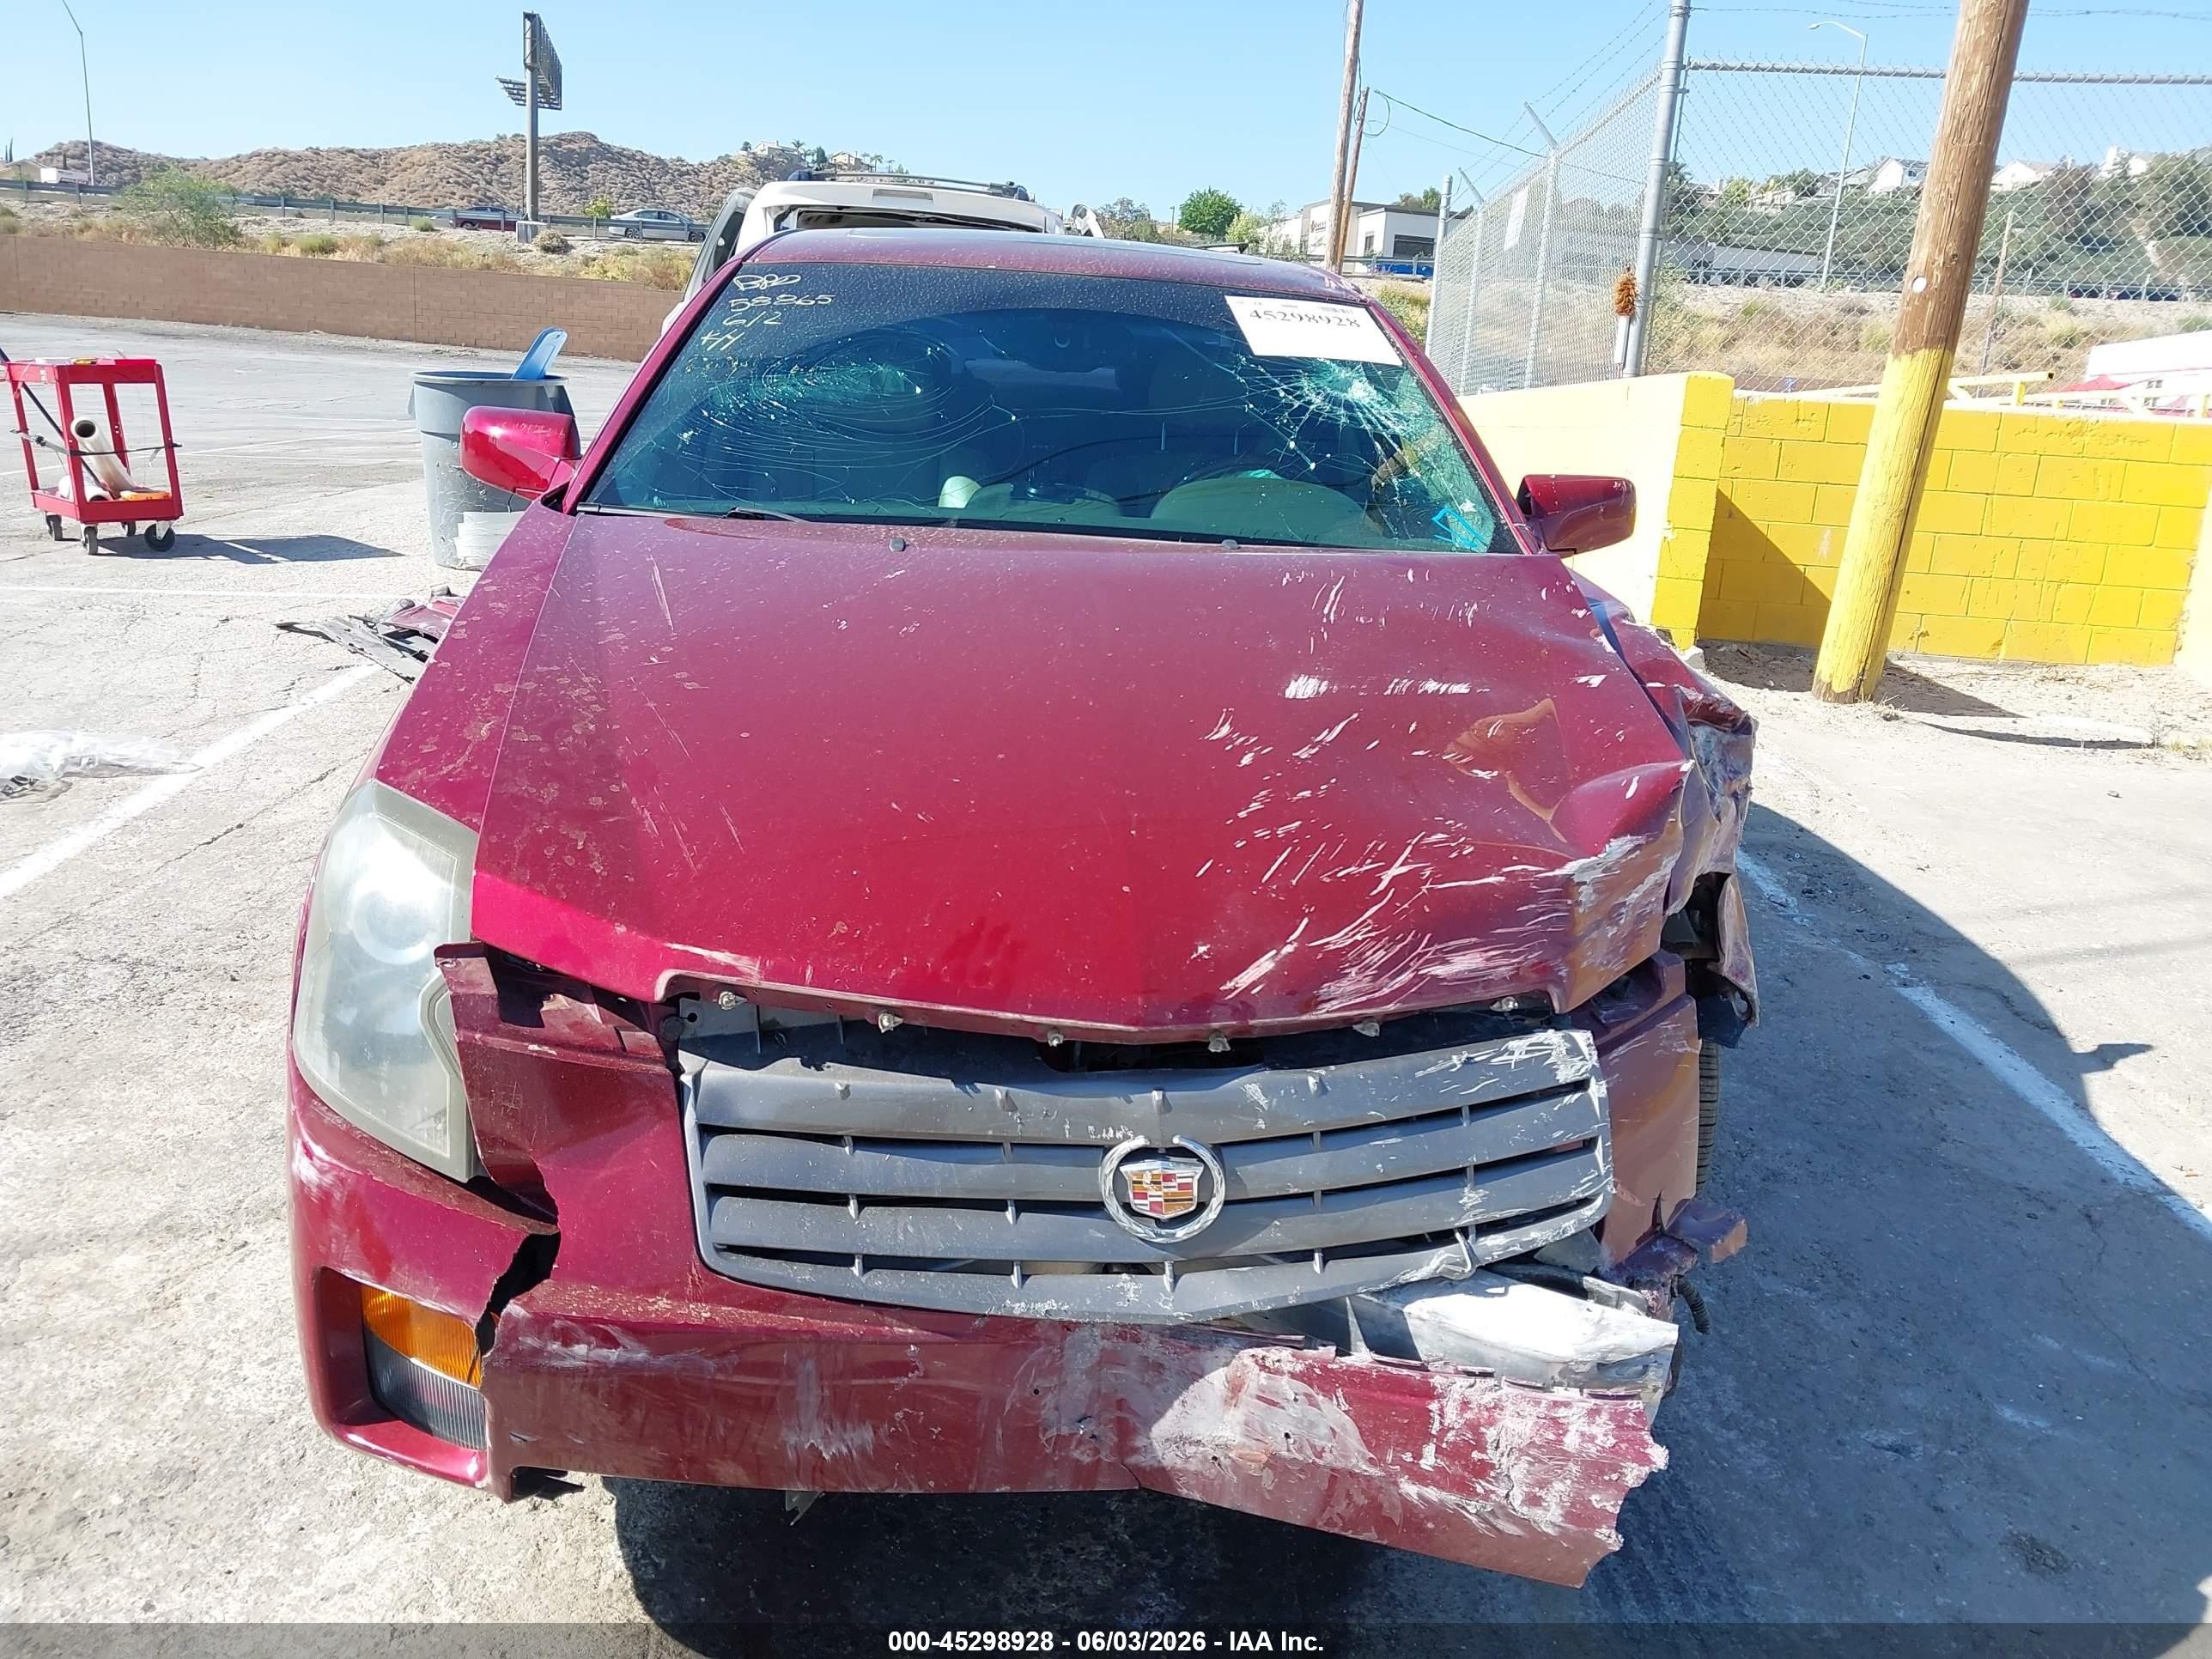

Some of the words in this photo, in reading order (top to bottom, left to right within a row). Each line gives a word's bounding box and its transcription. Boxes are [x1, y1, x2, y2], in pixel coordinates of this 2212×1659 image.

[728, 294, 836, 312] 58865
[722, 311, 783, 327] 6/2
[1249, 309, 1361, 328] 45298928
